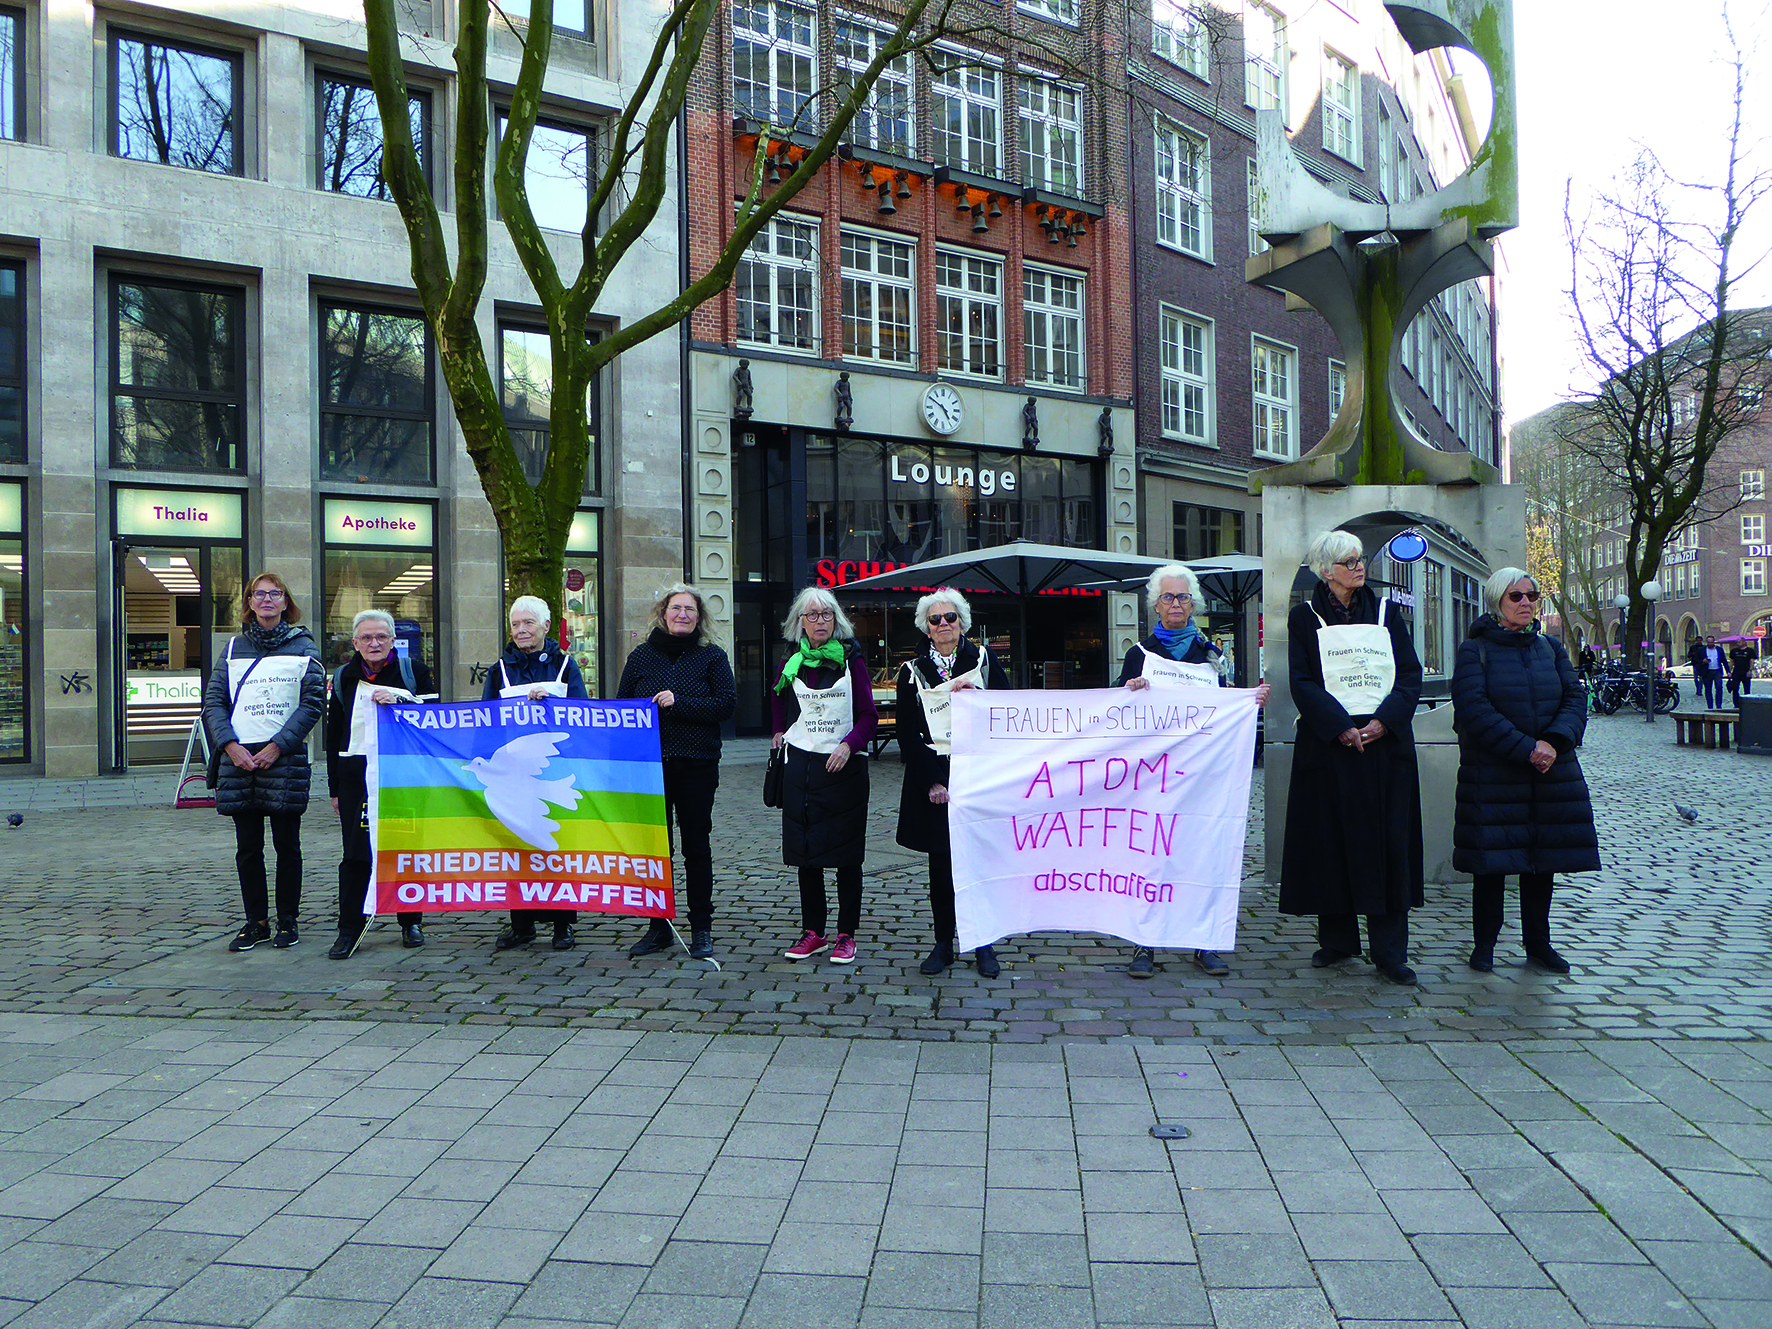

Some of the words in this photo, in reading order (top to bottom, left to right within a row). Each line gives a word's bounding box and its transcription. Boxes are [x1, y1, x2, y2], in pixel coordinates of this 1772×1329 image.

[746, 434, 754, 443] 12
[891, 455, 1016, 495] Lounge
[153, 506, 208, 521] Thalia
[342, 515, 416, 531] Apotheke
[1327, 648, 1353, 656] Frauen
[1153, 669, 1177, 678] Frauen
[1340, 674, 1362, 682] gegen
[146, 682, 201, 698] Thalia
[1348, 680, 1362, 688] und
[1364, 680, 1382, 689] Krieg
[244, 703, 264, 712] gegen
[265, 701, 290, 709] Gewalt
[266, 708, 284, 716] Krieg
[930, 701, 950, 714] Frauen
[500, 701, 547, 726] FÜR
[553, 705, 652, 729] FRIEDEN
[989, 706, 1082, 733] FRAUEN
[1089, 714, 1100, 725] in
[1105, 705, 1217, 731] SCHWARZ
[1025, 753, 1185, 798] ATOM-
[1012, 807, 1178, 856] WAFFEN
[397, 851, 520, 874] FRIEDEN
[529, 852, 664, 880] SCHAFFEN
[1034, 869, 1173, 902] abschaffen
[397, 882, 507, 903] OHNE
[519, 882, 667, 910] WAFFEN
